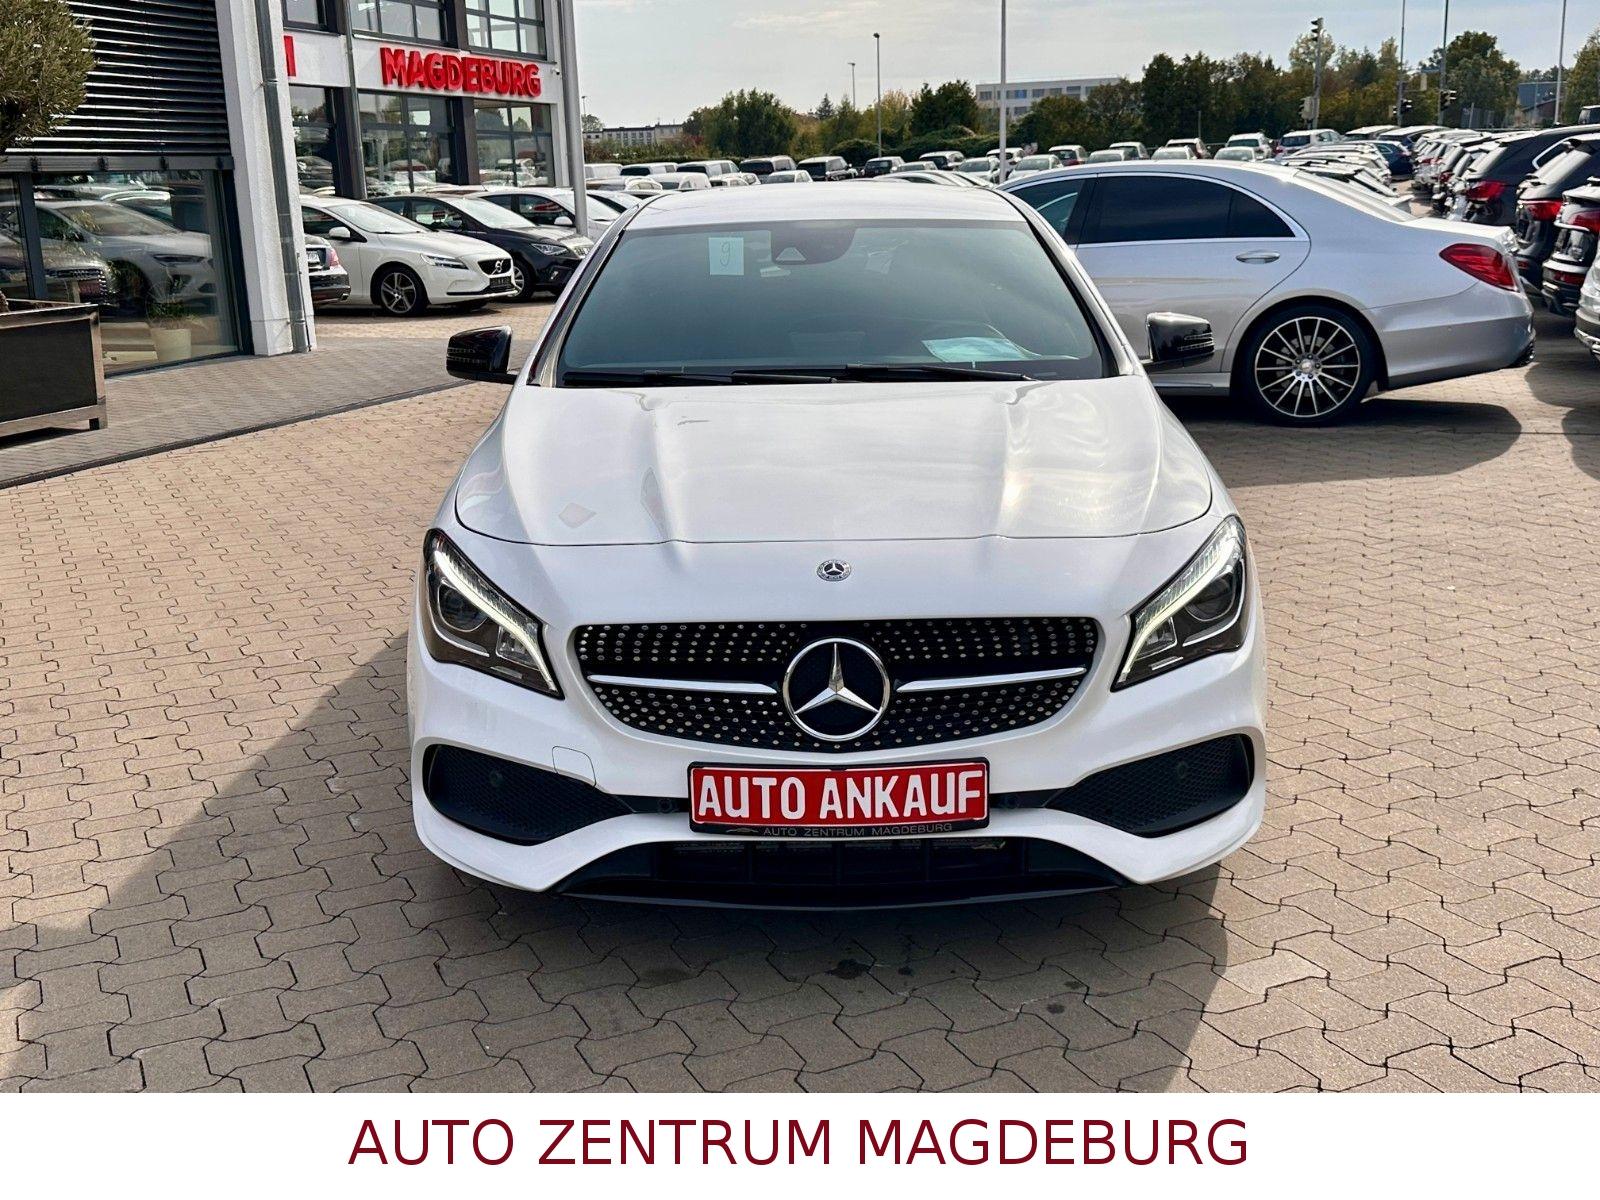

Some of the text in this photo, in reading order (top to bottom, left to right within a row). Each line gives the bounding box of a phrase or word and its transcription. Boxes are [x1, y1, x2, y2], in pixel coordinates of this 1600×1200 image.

[380, 47, 541, 97] MAGDEBURG
[698, 769, 983, 820] AUTO ANKAUF
[763, 823, 953, 837] AUTO ZENTRUM MAGDEBURG
